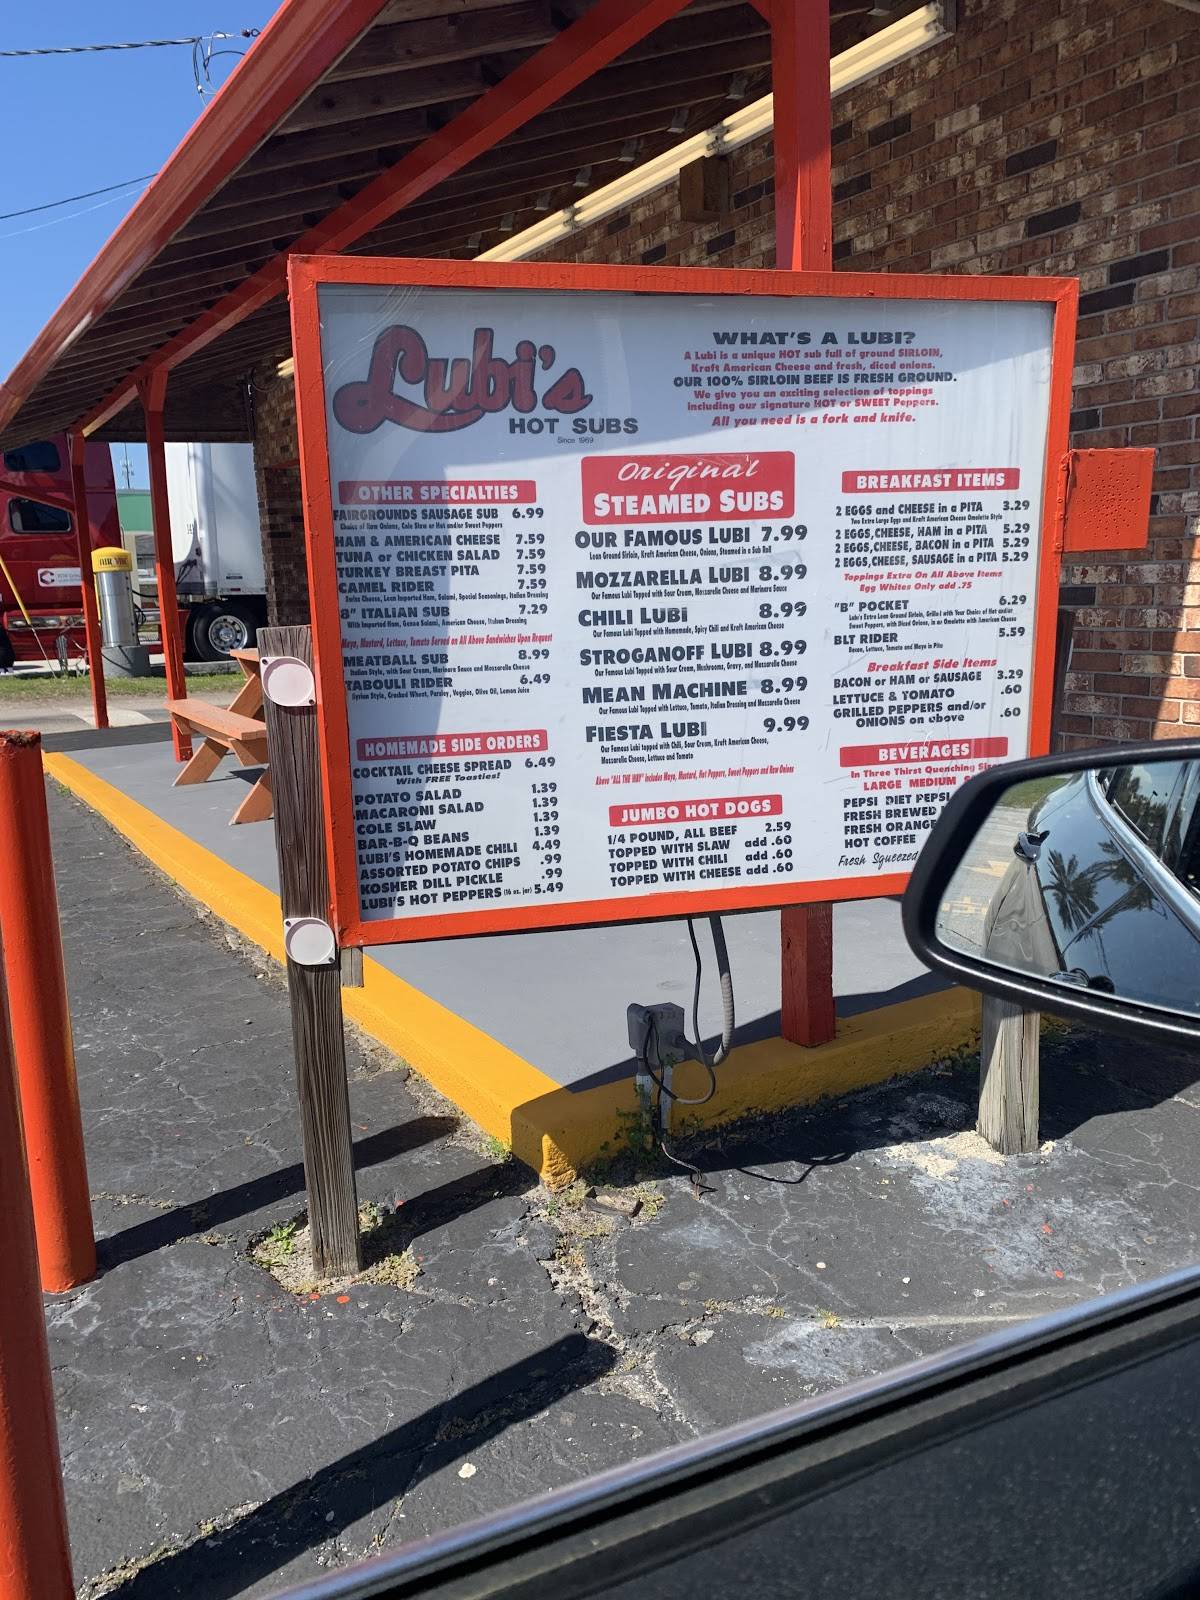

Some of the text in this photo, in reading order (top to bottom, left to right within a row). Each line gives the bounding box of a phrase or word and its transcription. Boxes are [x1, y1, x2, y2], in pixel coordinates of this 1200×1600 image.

[713, 331, 916, 345] WHAT'S A LUBI?
[695, 352, 716, 360] Lubi
[741, 352, 776, 361] unique
[779, 350, 800, 358] HOT
[804, 349, 821, 358] sub
[825, 349, 842, 358] full
[846, 349, 855, 357] of
[859, 349, 895, 359] ground
[898, 349, 942, 358] SIRLOIN,
[333, 324, 593, 434] Lubi's
[673, 372, 956, 387] OUR 100% SIRLOIN BEEF IS FRESH GROUND.
[509, 418, 639, 434] HOT SUBS
[712, 416, 730, 426] All
[734, 417, 756, 427] you
[761, 414, 792, 425] need
[796, 414, 807, 424] is
[823, 413, 849, 423] fork
[854, 413, 876, 422] and
[881, 412, 916, 422] knife.
[617, 459, 759, 491] Original
[857, 473, 1005, 489] BREAKFAST ITEMS
[359, 485, 518, 500] OTHER SPECIALTIES
[594, 489, 783, 516] STEAMED SUBS
[333, 508, 544, 520] FAIRGROUNDS SAUSAGE SUB 6.99
[335, 534, 544, 547] HAM & AMERICAN CHEESE 7.59
[575, 525, 807, 548] OUR FAMOUS LUBI 7.99
[336, 549, 545, 562] TUNA or CHICKEN SALAD 7.59
[337, 564, 546, 578] TURKEY BREAST PITA 7.59
[576, 564, 807, 588] MOZZARELLA LUBI 8.99
[338, 579, 547, 593] CAMEL RIDER 7.59
[860, 584, 876, 592] Egg
[879, 583, 911, 591] Whites
[914, 582, 935, 591] Only
[341, 604, 548, 619] 8" ITALIAN SUB 7.29
[834, 595, 1027, 612] "B" POCKET 6.29
[834, 627, 1025, 645] BLT RIDER 5.59
[344, 649, 549, 667] MEATBALL SUB 8.99
[580, 640, 807, 665] STROGANOFF LUBI 8.99
[867, 658, 997, 672] Breakfast Side Items
[345, 674, 550, 691] TABOULI RIDER 6.49
[582, 676, 807, 704] MEAN MACHINE 8.99
[586, 716, 809, 742] FIESTA LUBI 9.99
[365, 735, 540, 757] HOMEMADE SIDE ORDERS
[879, 744, 969, 761] BEVERAGES
[628, 755, 647, 763] Cheese,
[353, 757, 555, 779] COCKTAIL CHEESE SPREAD 6.49
[396, 777, 422, 785] With
[455, 772, 500, 782] Toasties!
[355, 783, 557, 805] POTATO SALAD 1.39
[844, 792, 949, 808] PEPSI DIET PEPSI
[621, 800, 771, 822] JUMBO HOT DOGS
[357, 811, 559, 834] COLE SLAW 1.39
[358, 825, 559, 850] BAR-B-Q BEANS 1.39
[608, 821, 791, 845] 1/4 POUND, ALL BEEF 2.59
[845, 835, 915, 848] HOT COFFEE
[839, 851, 918, 870] Fresh Squeezed
[362, 896, 405, 910] LUBI'S
[410, 893, 438, 906] HOT
[443, 888, 501, 902] PEPPERS
[523, 887, 532, 895] jar)
[534, 882, 563, 894] 5.49
